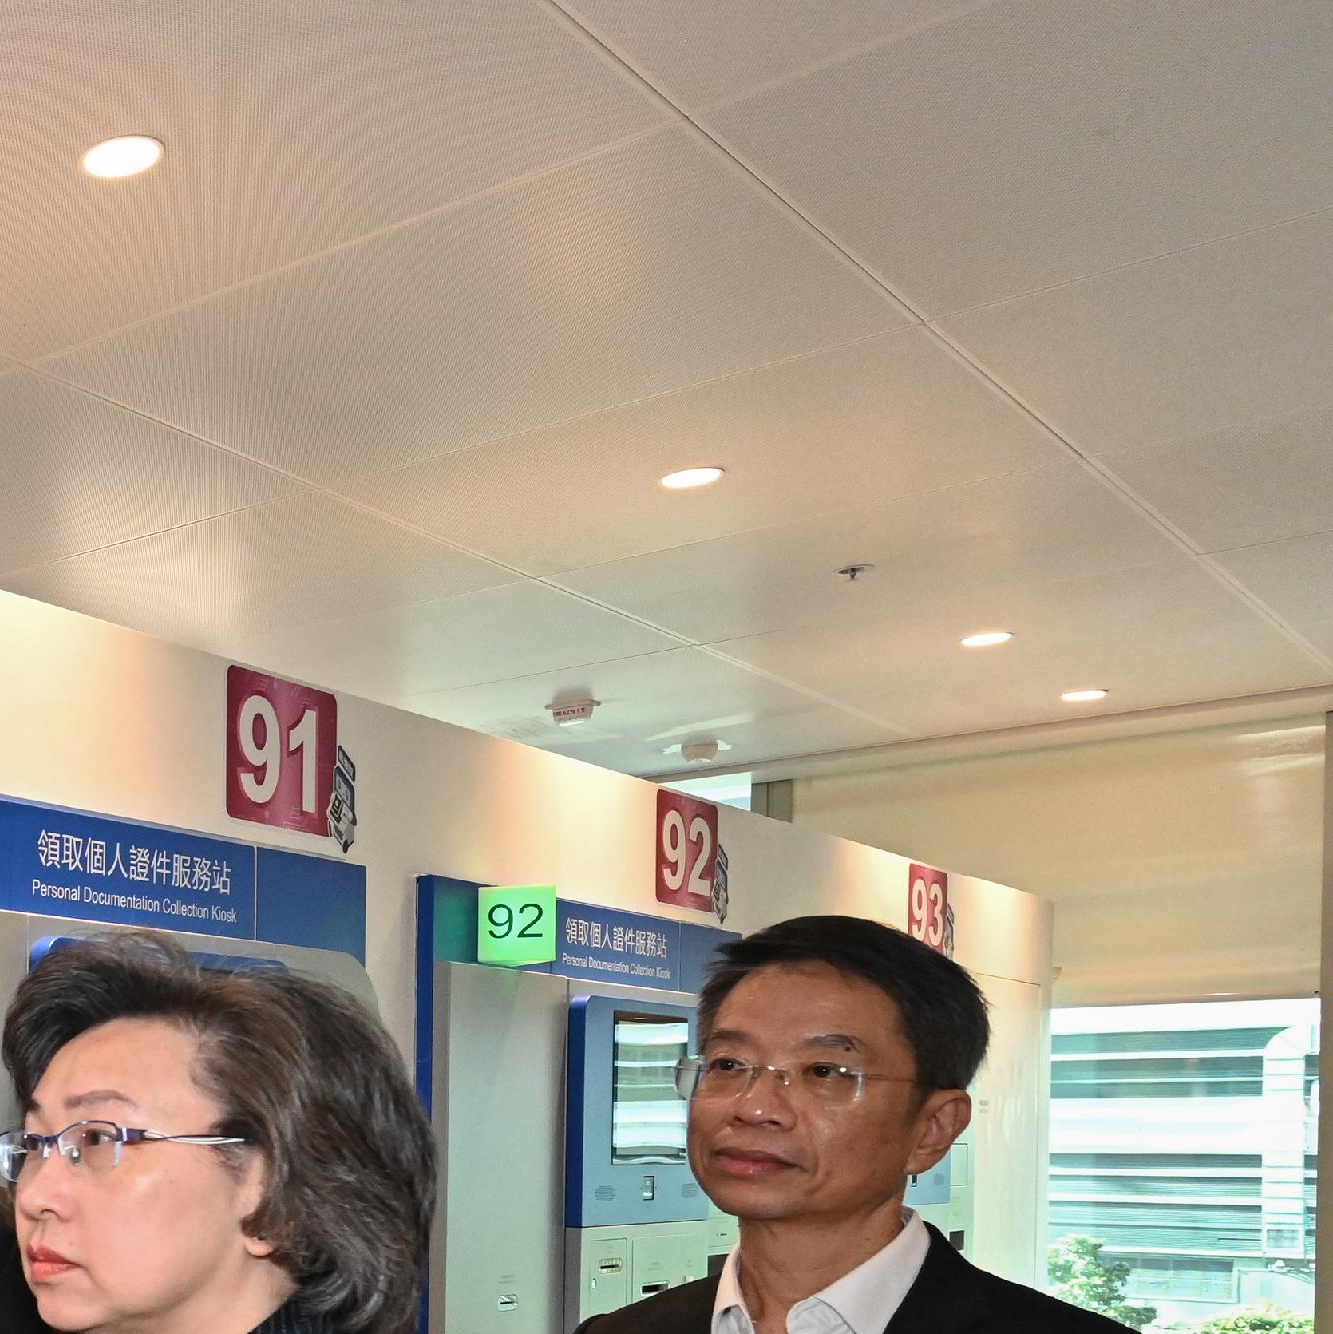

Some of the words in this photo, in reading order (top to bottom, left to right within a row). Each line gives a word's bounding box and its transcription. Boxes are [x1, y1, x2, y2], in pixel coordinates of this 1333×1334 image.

[239, 694, 317, 814] 91
[37, 829, 232, 896] 領取個人證件服務站
[662, 809, 711, 897] 92
[32, 880, 81, 901] Personal
[84, 887, 160, 913] Documentation
[163, 898, 209, 920] Collection
[211, 904, 238, 924] Kiosk
[487, 903, 544, 939] 92
[912, 878, 944, 946] 93
[562, 952, 588, 968] Personal
[589, 956, 630, 975] Documentation
[565, 917, 668, 960] 領取個人證件服務站
